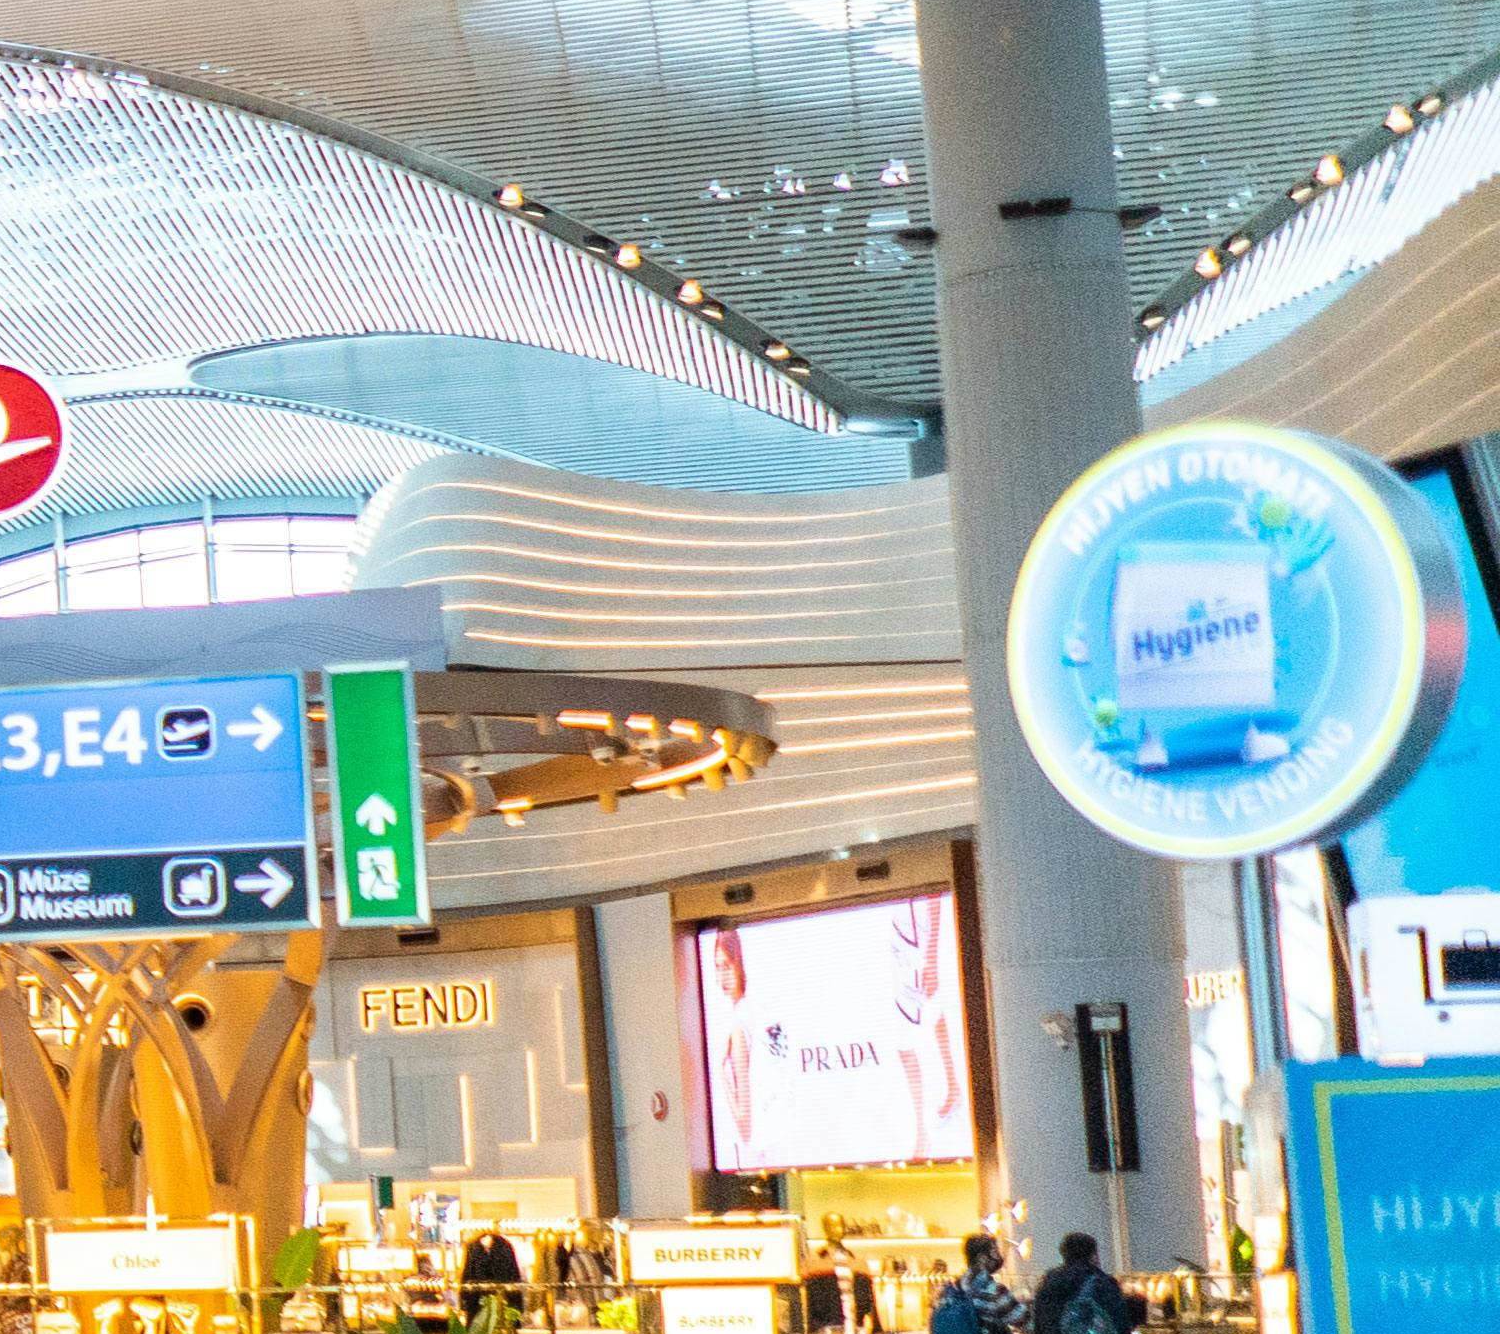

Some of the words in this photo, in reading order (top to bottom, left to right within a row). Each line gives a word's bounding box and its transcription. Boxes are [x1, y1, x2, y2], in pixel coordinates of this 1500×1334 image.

[1131, 606, 1262, 664] Hygiene
[1213, 717, 1355, 820] VENDING
[18, 865, 91, 895] Müze
[18, 893, 136, 922] Museum
[361, 980, 491, 1031] FENDI
[800, 1041, 880, 1073] PRADA
[654, 1247, 764, 1264] BURBERRY
